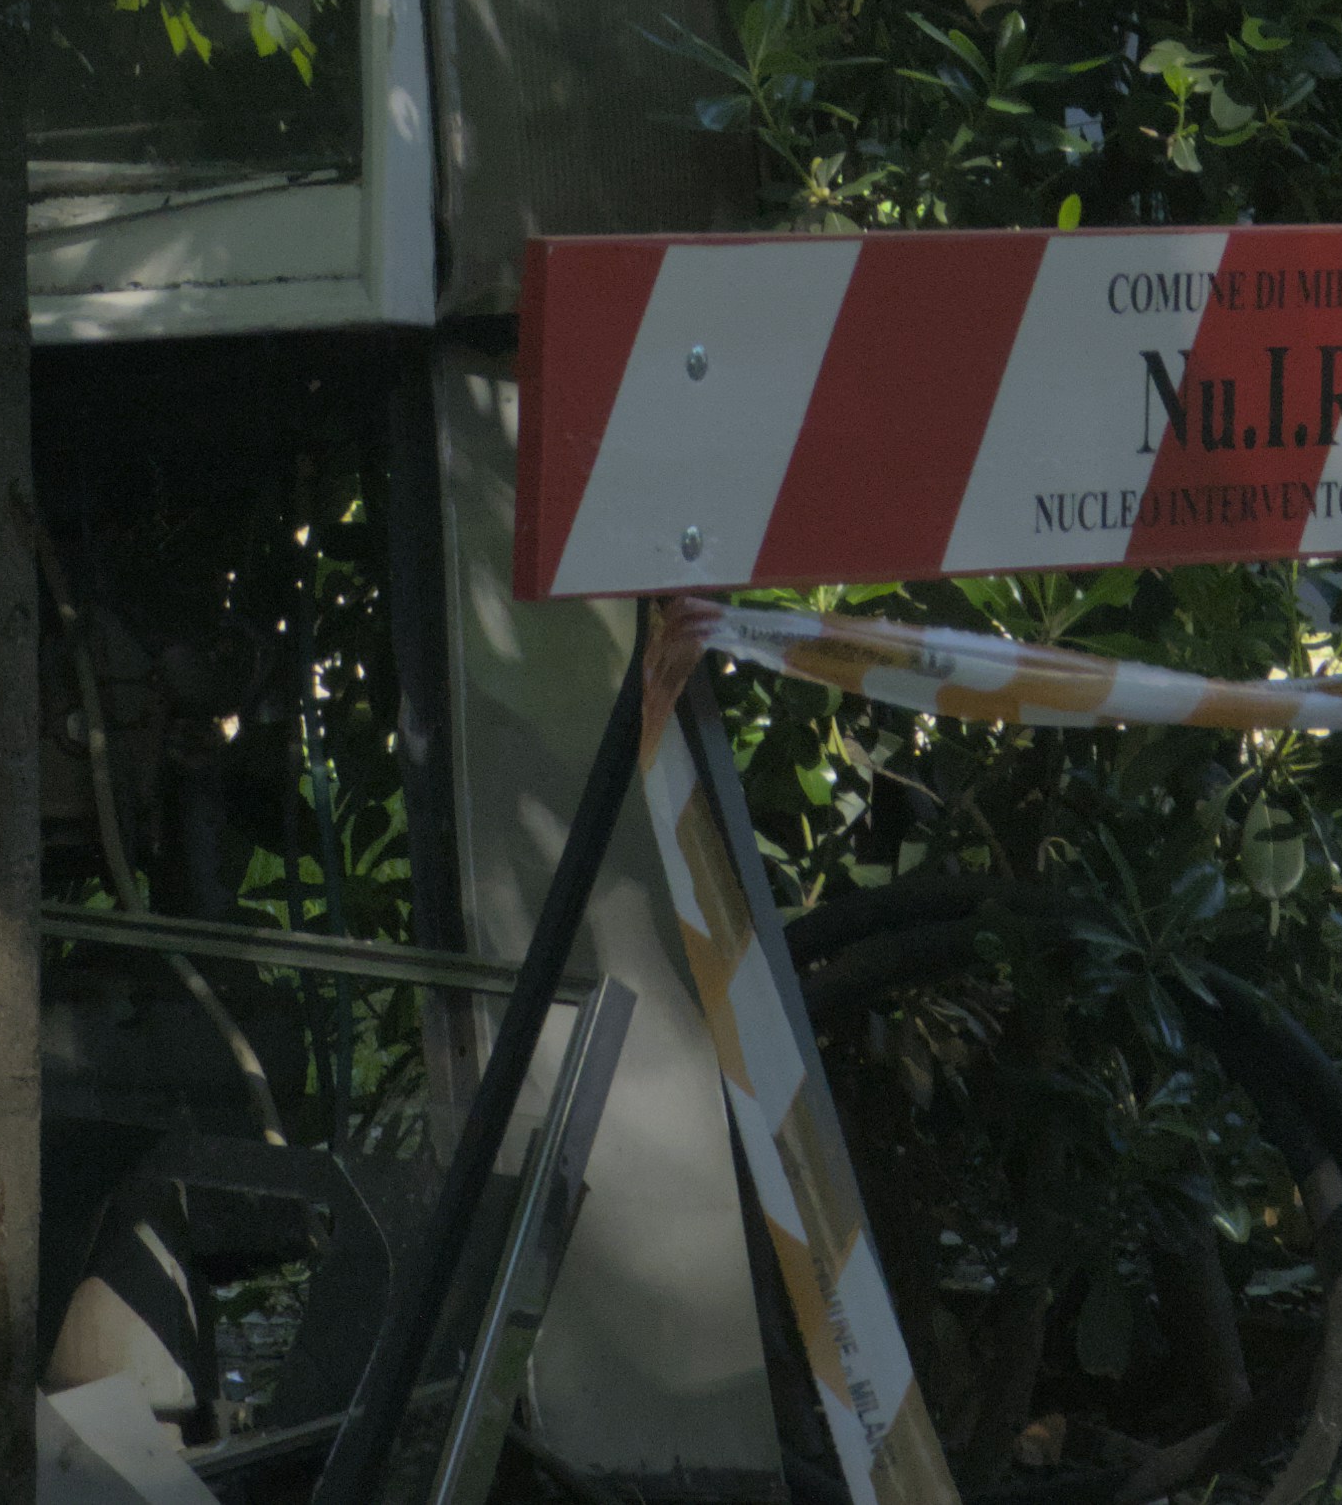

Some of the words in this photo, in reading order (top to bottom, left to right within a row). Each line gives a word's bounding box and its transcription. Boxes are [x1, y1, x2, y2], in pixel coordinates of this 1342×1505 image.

[1107, 271, 1245, 315] COMUNE
[1254, 271, 1286, 310] DI
[1034, 490, 1158, 534] NUCLEO
